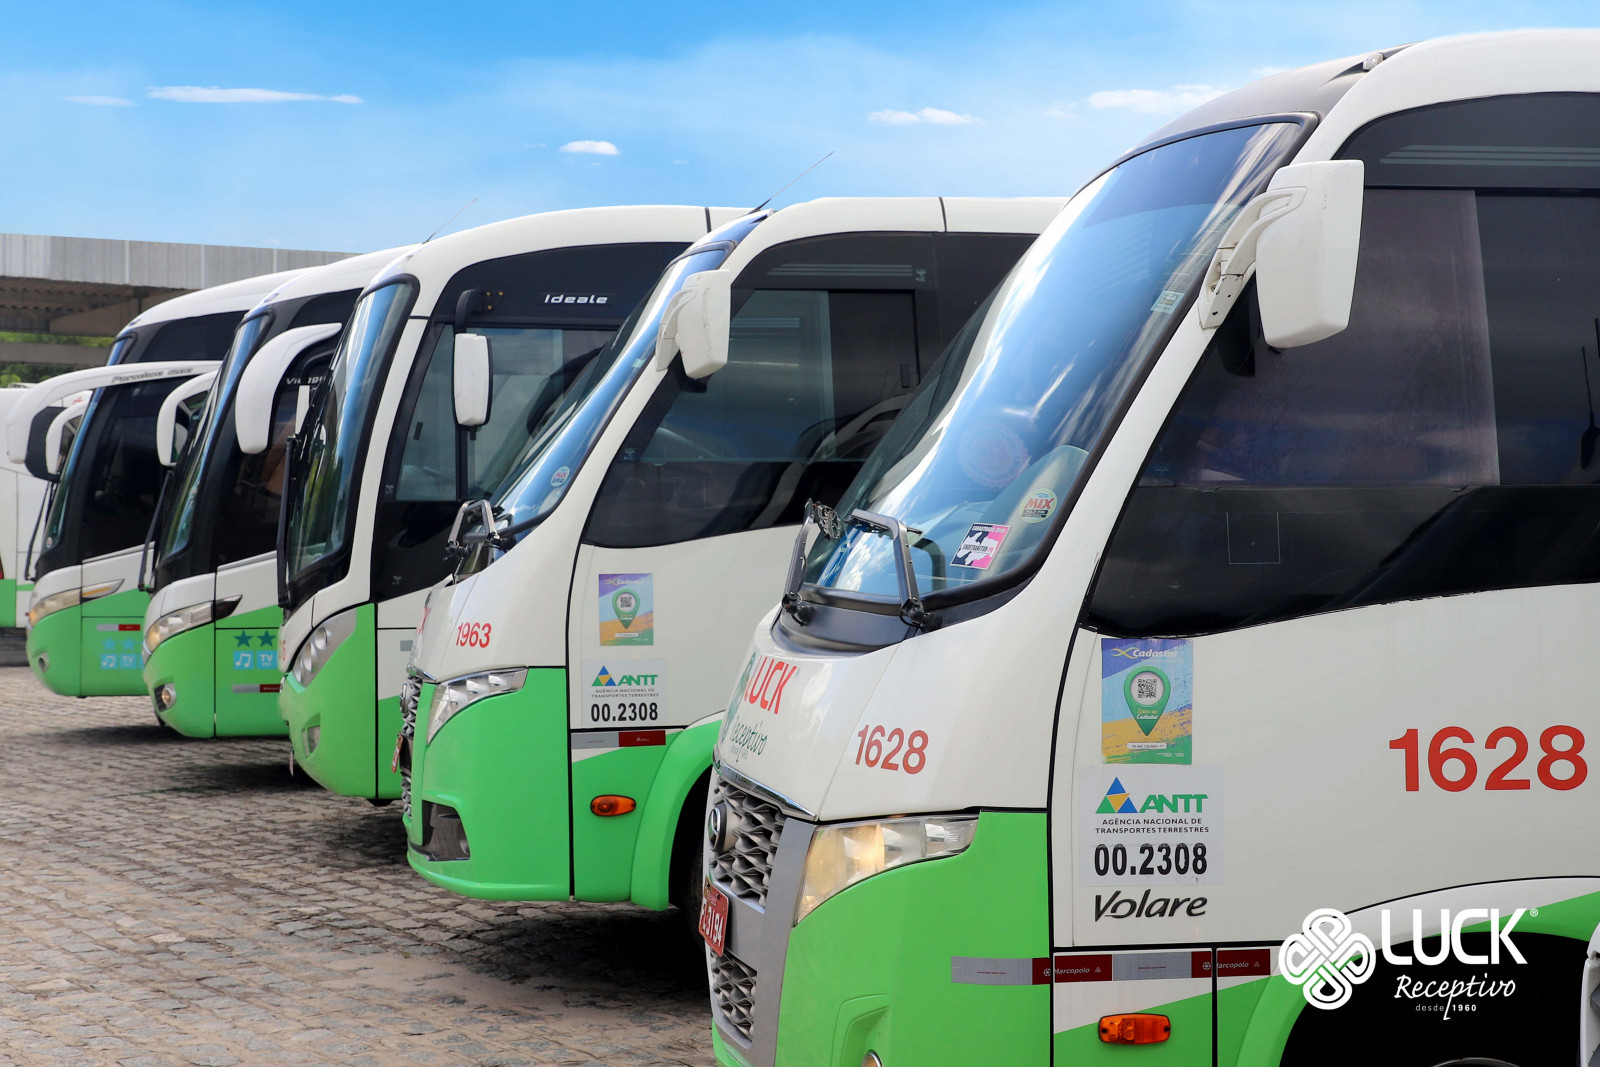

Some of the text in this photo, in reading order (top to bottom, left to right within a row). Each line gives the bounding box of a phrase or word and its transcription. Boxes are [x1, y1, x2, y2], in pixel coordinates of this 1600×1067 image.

[544, 294, 608, 304] Ideale
[1024, 498, 1055, 510] MIX
[455, 622, 492, 649] 1963
[260, 654, 273, 662] TV
[1133, 649, 1178, 658] Cadastur
[618, 675, 658, 686] ANTT
[744, 655, 797, 715] LUCK
[591, 702, 658, 722] 00.2308
[855, 724, 929, 775] 1628
[1389, 725, 1588, 792] 1628
[1139, 794, 1208, 813] ANTT
[1094, 842, 1208, 876] 00.2308
[1094, 888, 1208, 922] Volare
